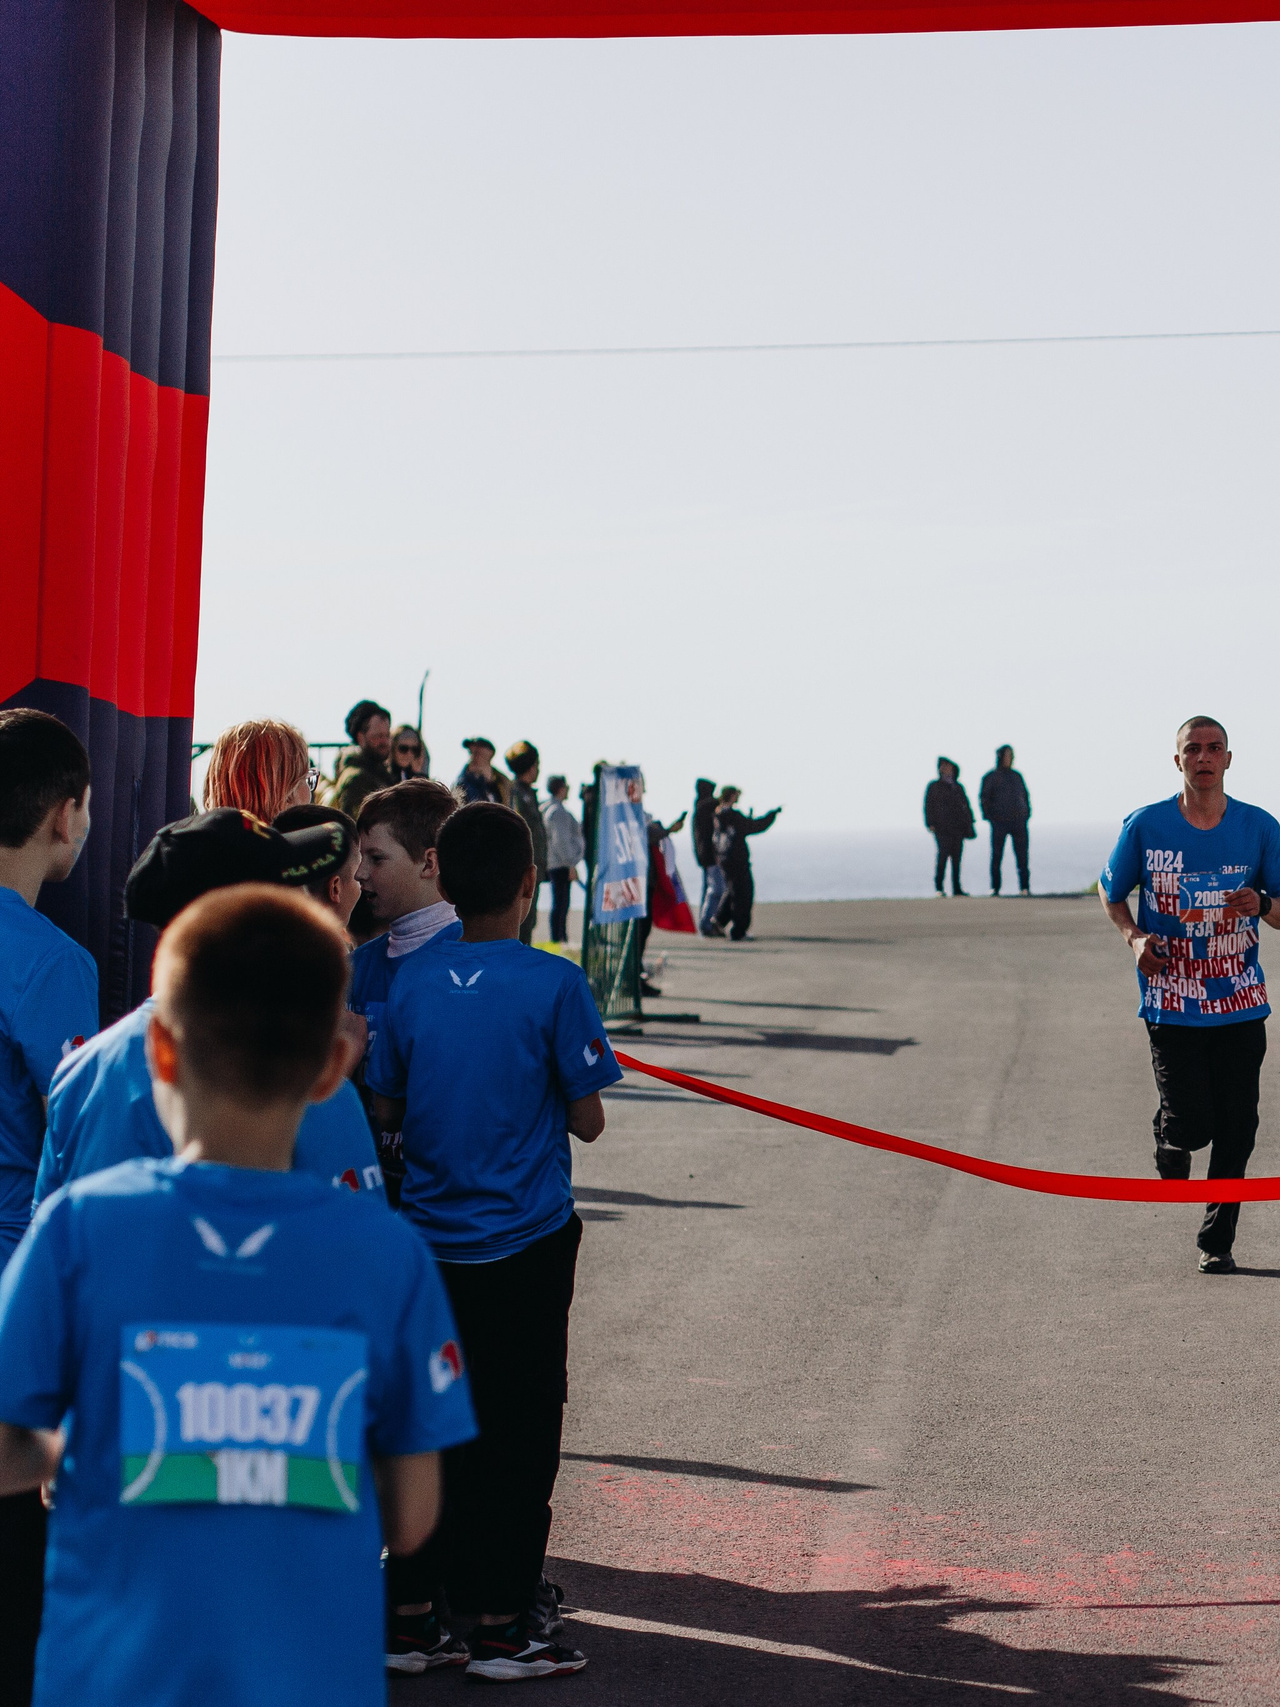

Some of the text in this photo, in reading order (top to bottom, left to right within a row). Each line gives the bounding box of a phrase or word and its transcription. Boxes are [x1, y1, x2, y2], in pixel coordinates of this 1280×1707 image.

[1146, 849, 1184, 872] 2024
[1152, 872, 1181, 895] #МЕ
[1194, 889, 1234, 907] 2005
[176, 1382, 321, 1446] 10037
